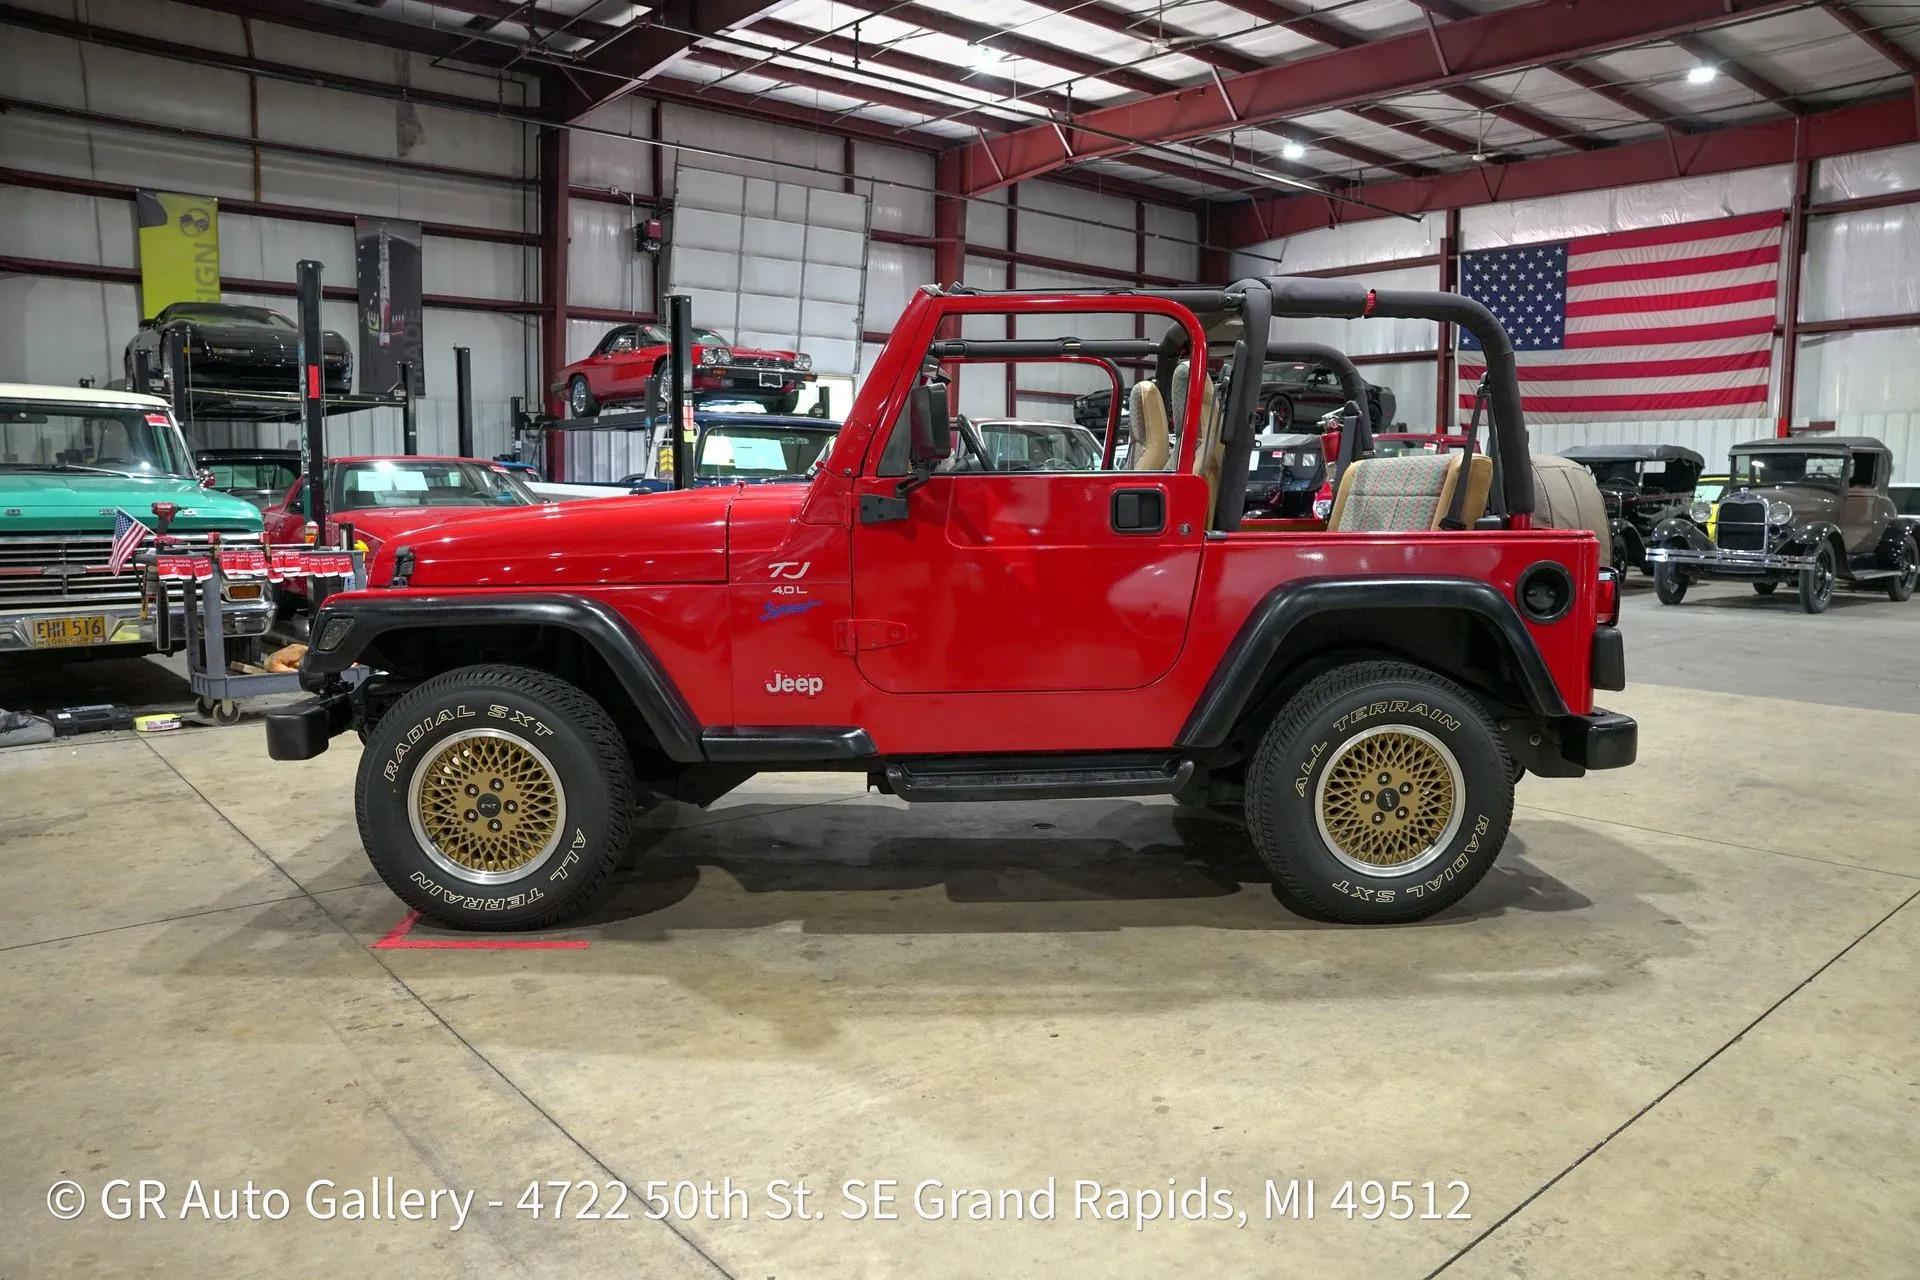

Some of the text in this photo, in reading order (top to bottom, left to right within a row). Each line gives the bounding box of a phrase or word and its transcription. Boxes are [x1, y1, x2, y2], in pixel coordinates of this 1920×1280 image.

[194, 242, 221, 302] IGN
[768, 562, 811, 580] TJ
[72, 619, 102, 637] 516
[766, 672, 824, 696] Jeep
[383, 704, 554, 782] RADIAL SXT
[1295, 700, 1462, 797] ALL TERRAIN
[410, 828, 587, 912] ALL TERRAIN
[1332, 814, 1490, 903] RADIAL SXT
